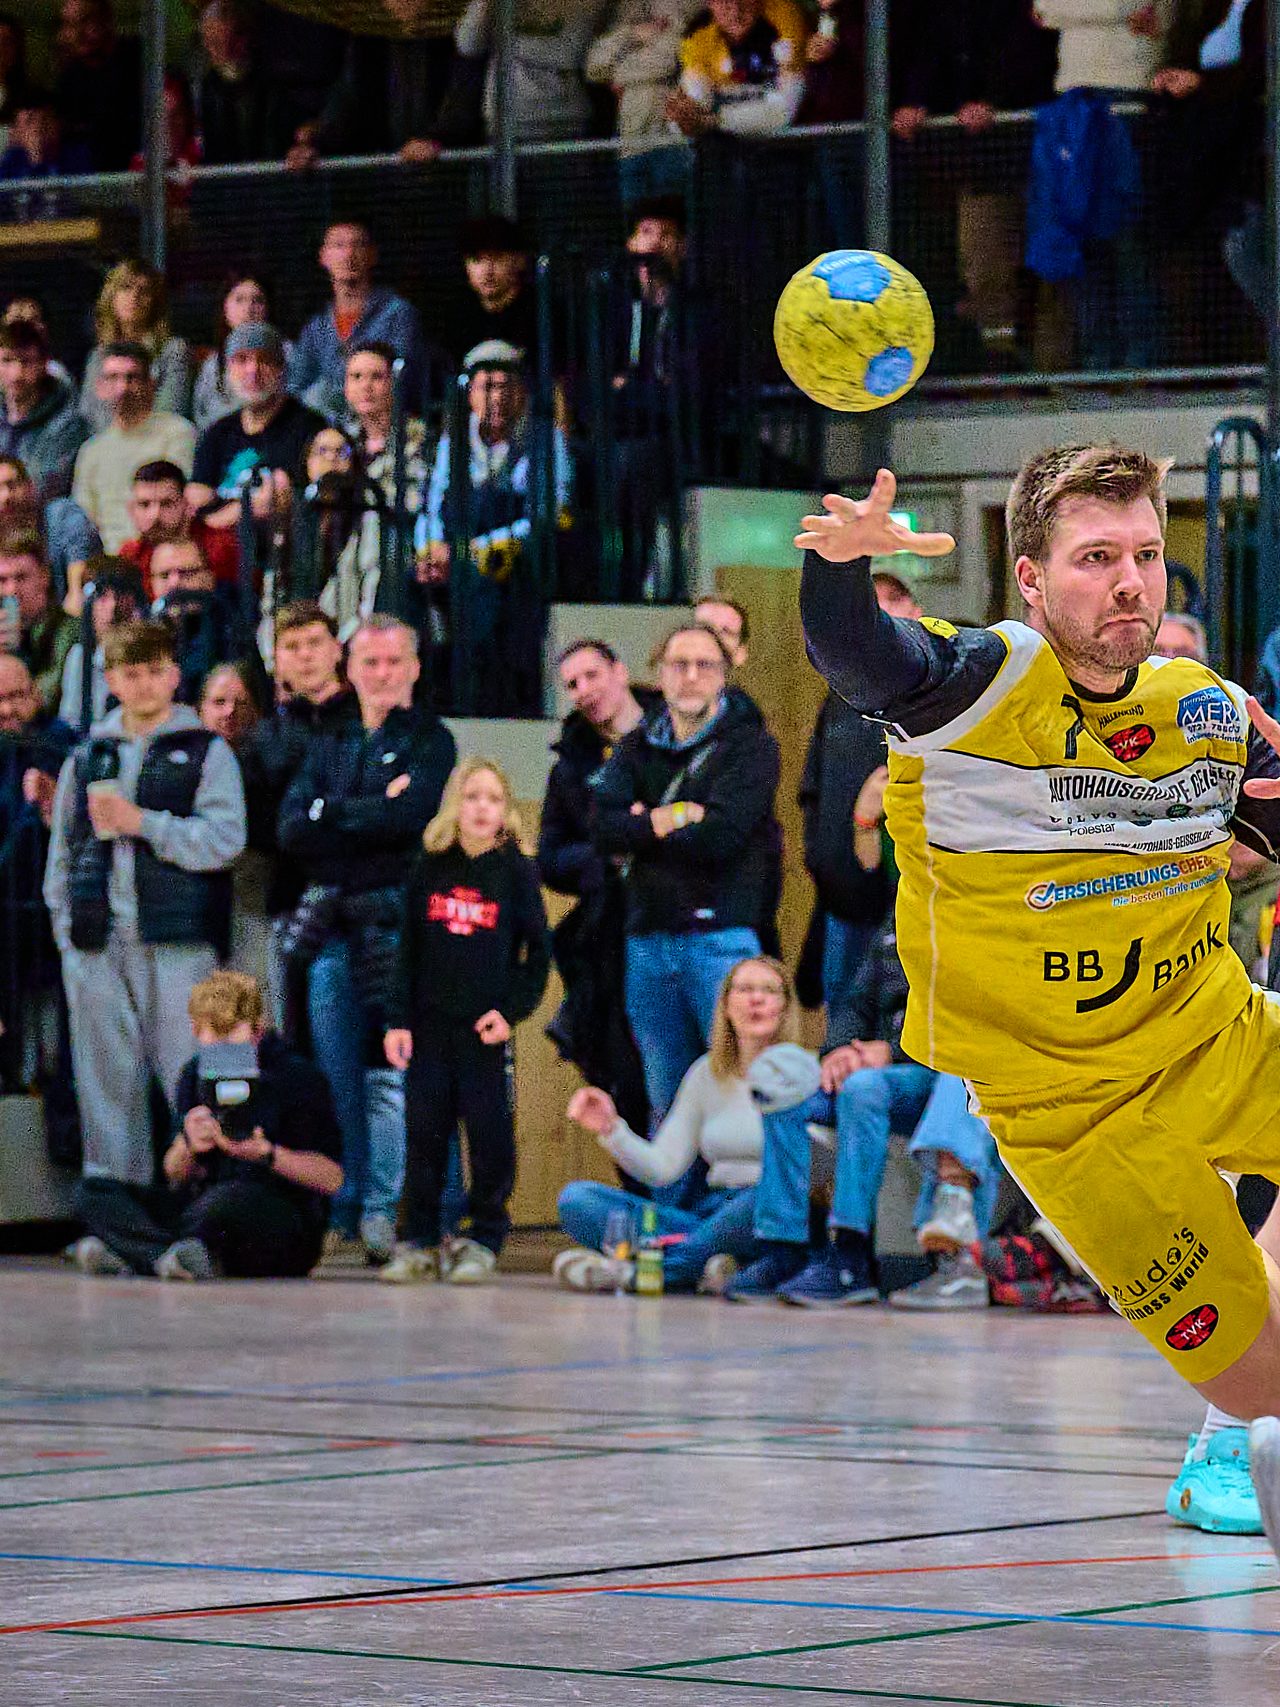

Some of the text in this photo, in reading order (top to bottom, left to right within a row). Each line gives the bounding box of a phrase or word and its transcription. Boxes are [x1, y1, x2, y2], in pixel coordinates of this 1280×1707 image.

[1061, 693, 1085, 760] 7
[1098, 704, 1145, 730] HALLENKIND
[1112, 736, 1138, 751] VK
[1131, 890, 1162, 904] besten
[1164, 882, 1189, 897] Tarife
[1043, 920, 1225, 993] BB Bank
[1168, 1241, 1209, 1292] World
[1180, 1318, 1206, 1341] TVK
